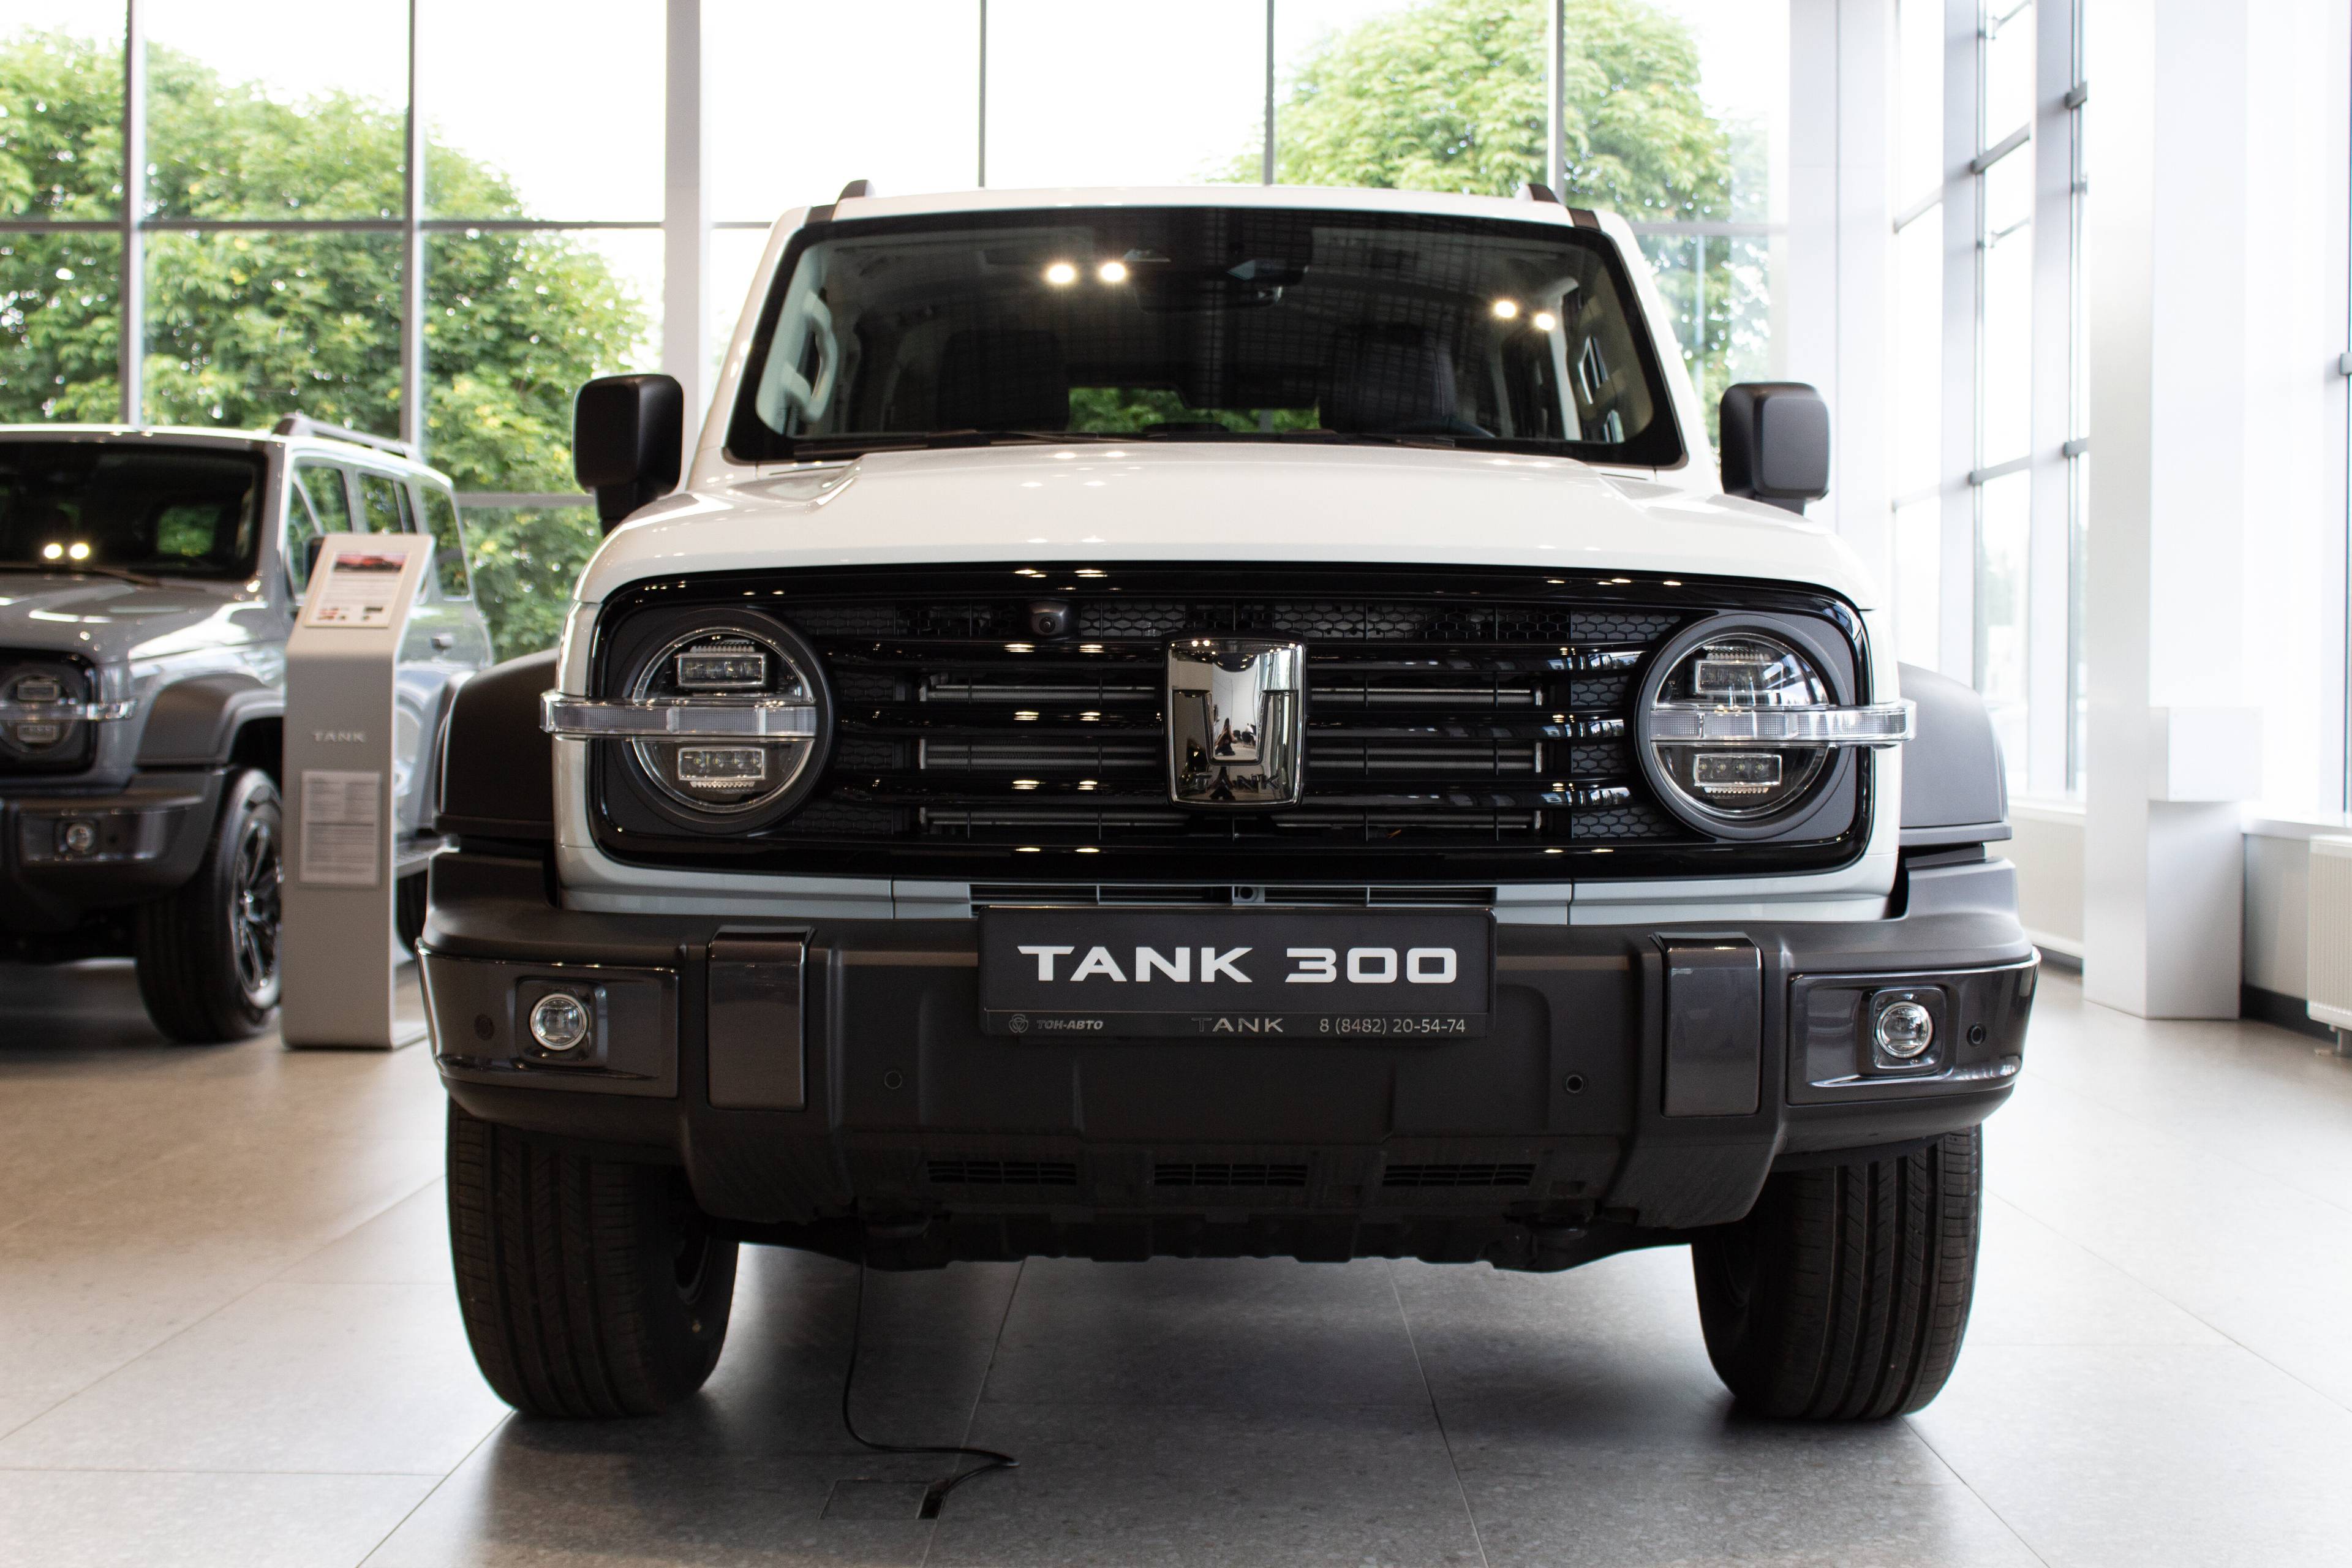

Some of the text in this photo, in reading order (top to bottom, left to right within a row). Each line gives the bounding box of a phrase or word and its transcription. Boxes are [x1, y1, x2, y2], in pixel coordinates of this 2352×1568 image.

[314, 731, 366, 743] TANK
[1193, 773, 1280, 791] TANK
[1017, 945, 1457, 984] TANK 300
[1036, 1019, 1104, 1030] ТОН-АВТО
[1191, 1017, 1283, 1033] TANK
[1319, 1017, 1466, 1035] 8 (8482) 20-54-74
